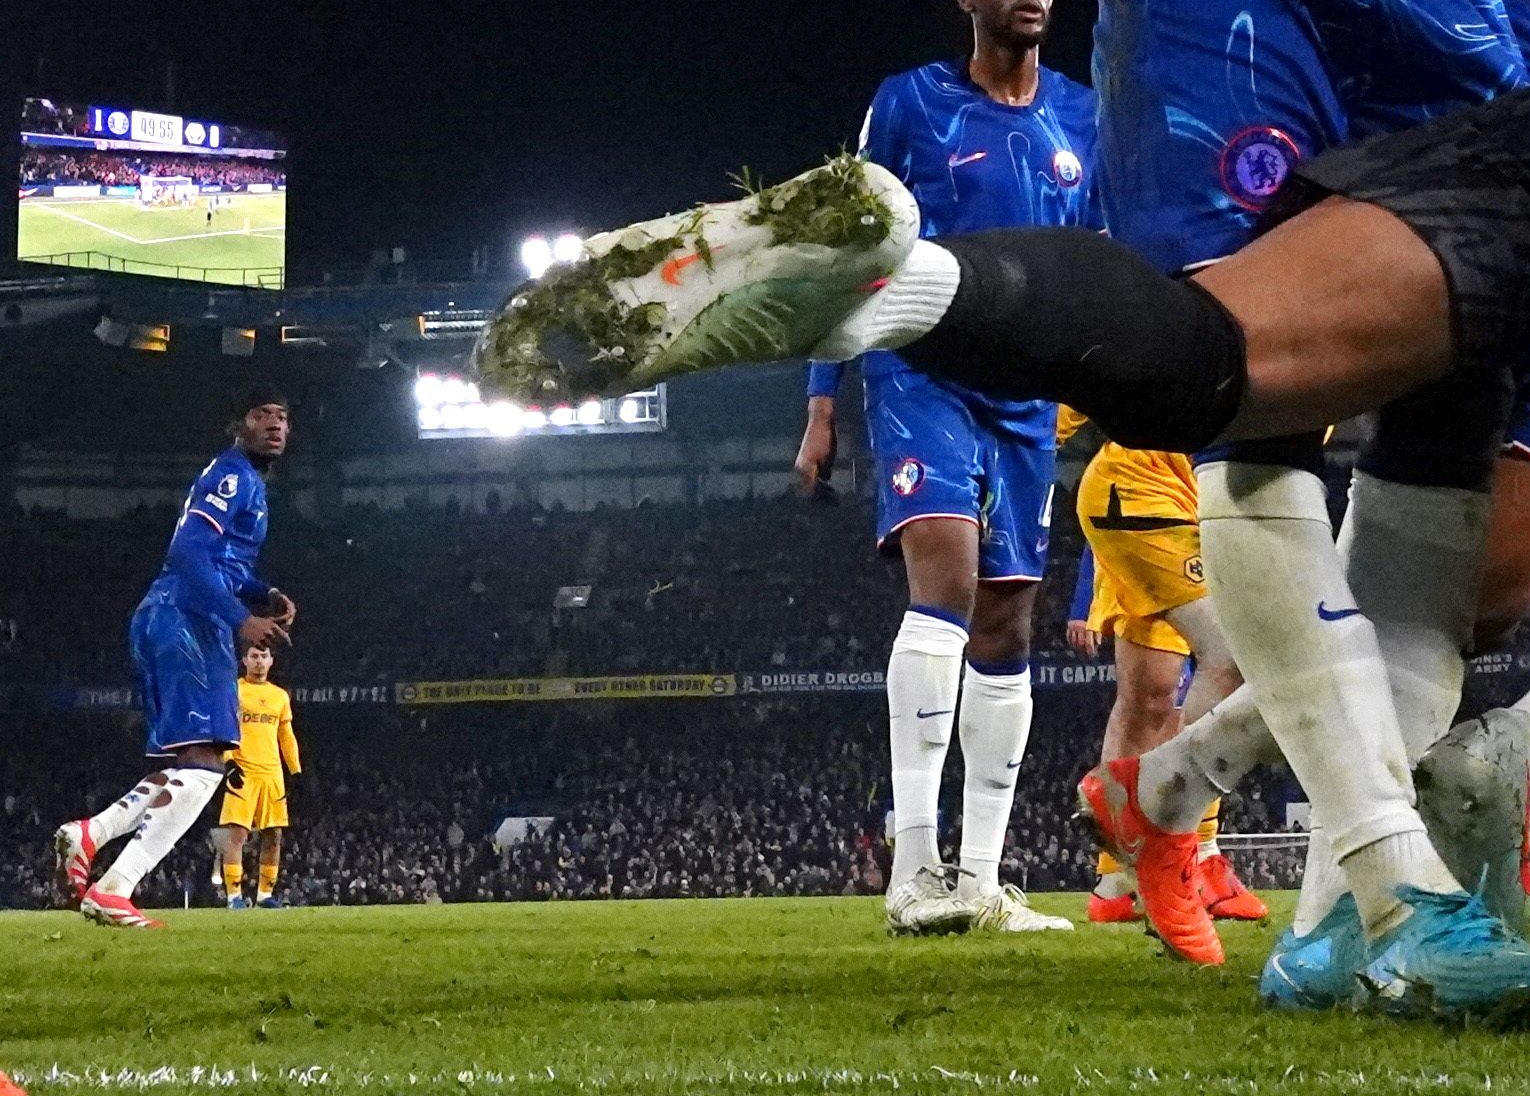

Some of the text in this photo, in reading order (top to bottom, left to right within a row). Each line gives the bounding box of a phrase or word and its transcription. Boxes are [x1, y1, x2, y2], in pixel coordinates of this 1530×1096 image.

[95, 109, 103, 132] 1
[1471, 653, 1513, 664] ING'S
[1062, 664, 1117, 684] CAPTA
[1474, 663, 1511, 674] ARMY
[649, 679, 705, 692] SATURDAY
[761, 673, 819, 686] DIDIER
[242, 712, 279, 726] DEBET
